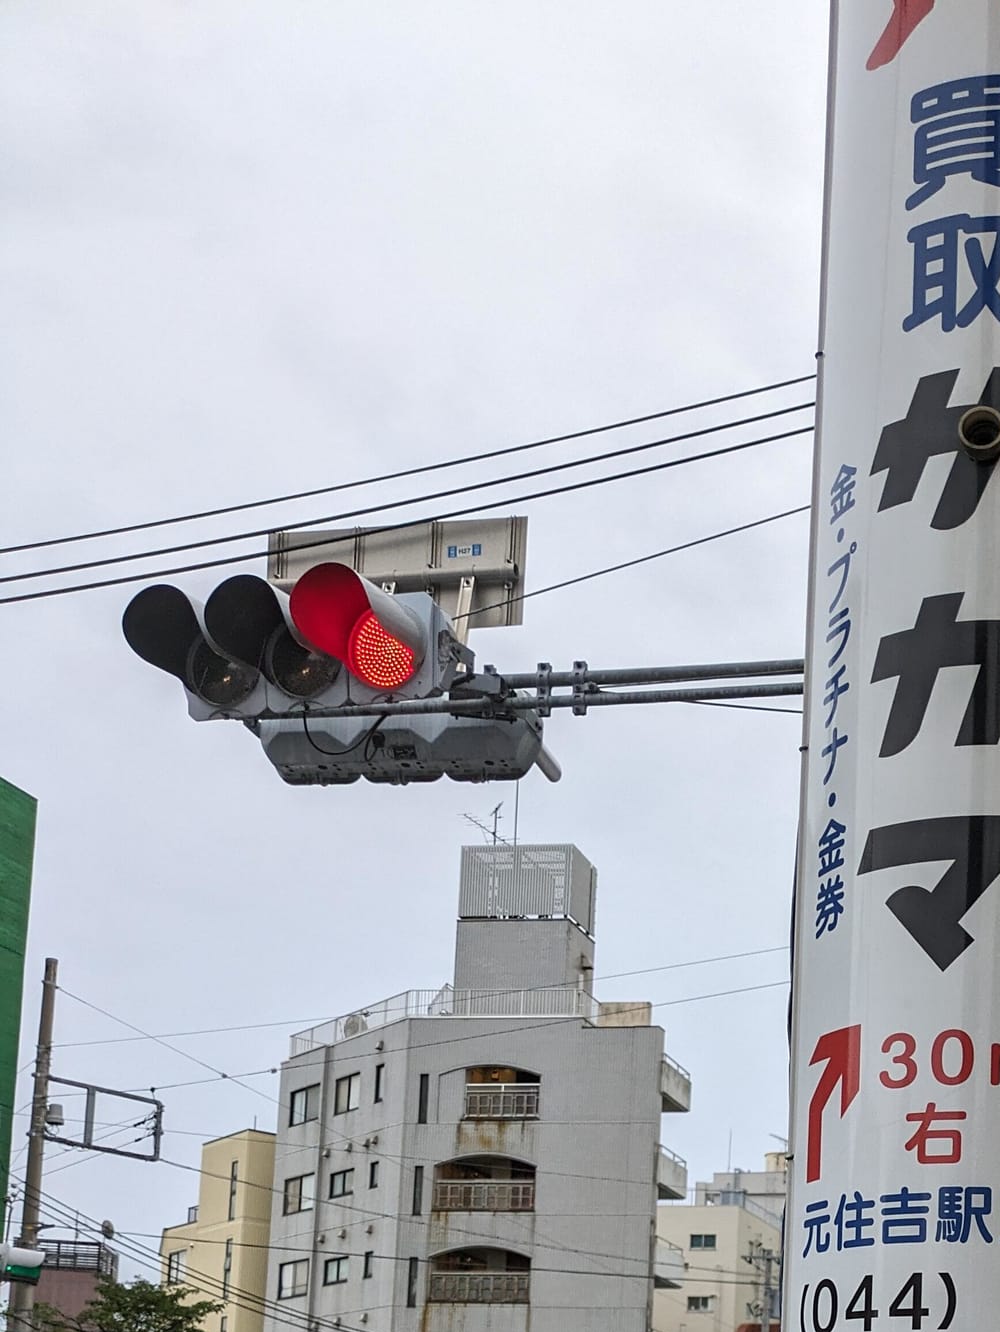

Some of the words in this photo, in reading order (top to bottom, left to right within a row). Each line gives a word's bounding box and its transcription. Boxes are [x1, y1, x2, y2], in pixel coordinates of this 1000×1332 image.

[815, 464, 858, 940] 金・プラチナ・金券
